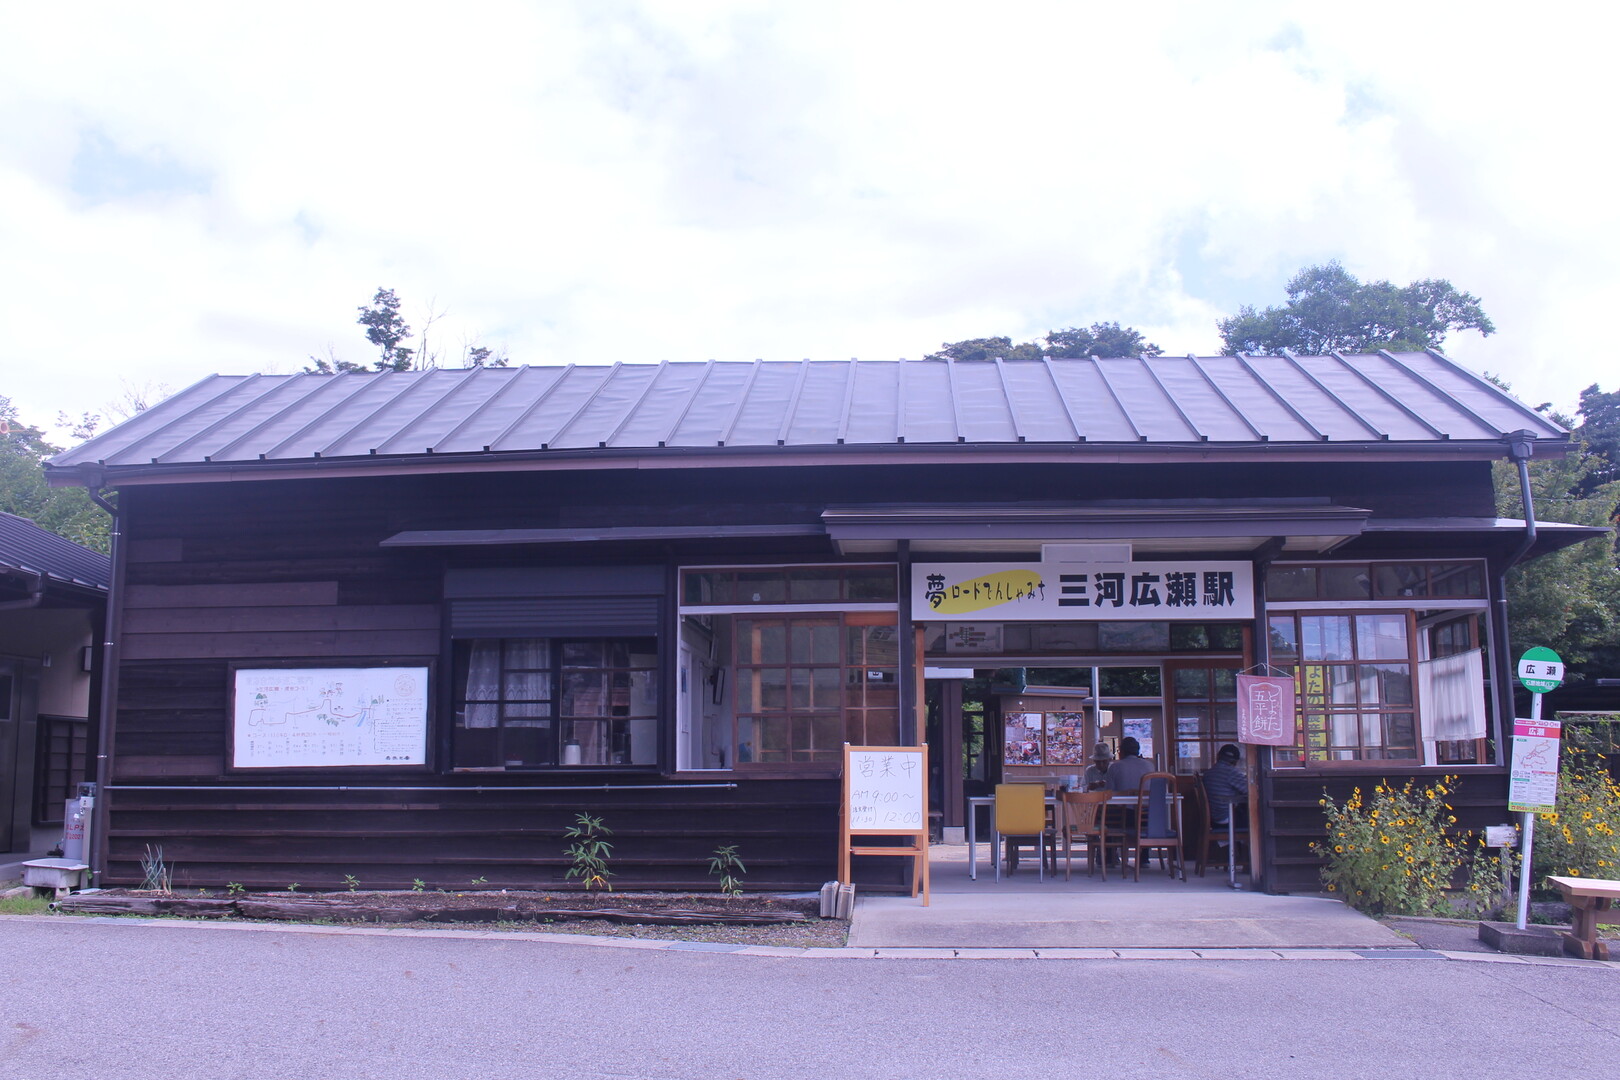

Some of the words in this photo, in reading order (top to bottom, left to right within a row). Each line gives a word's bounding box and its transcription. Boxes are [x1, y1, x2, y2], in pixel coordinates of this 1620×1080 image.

[1058, 571, 1235, 608] 三河広瀬駅
[1525, 664, 1557, 676] 広瀬
[1252, 690, 1268, 731] 五平餅
[1268, 690, 1281, 732] とよた
[858, 754, 918, 779] 営業中
[851, 790, 869, 800] AM
[884, 811, 921, 823] 12:00
